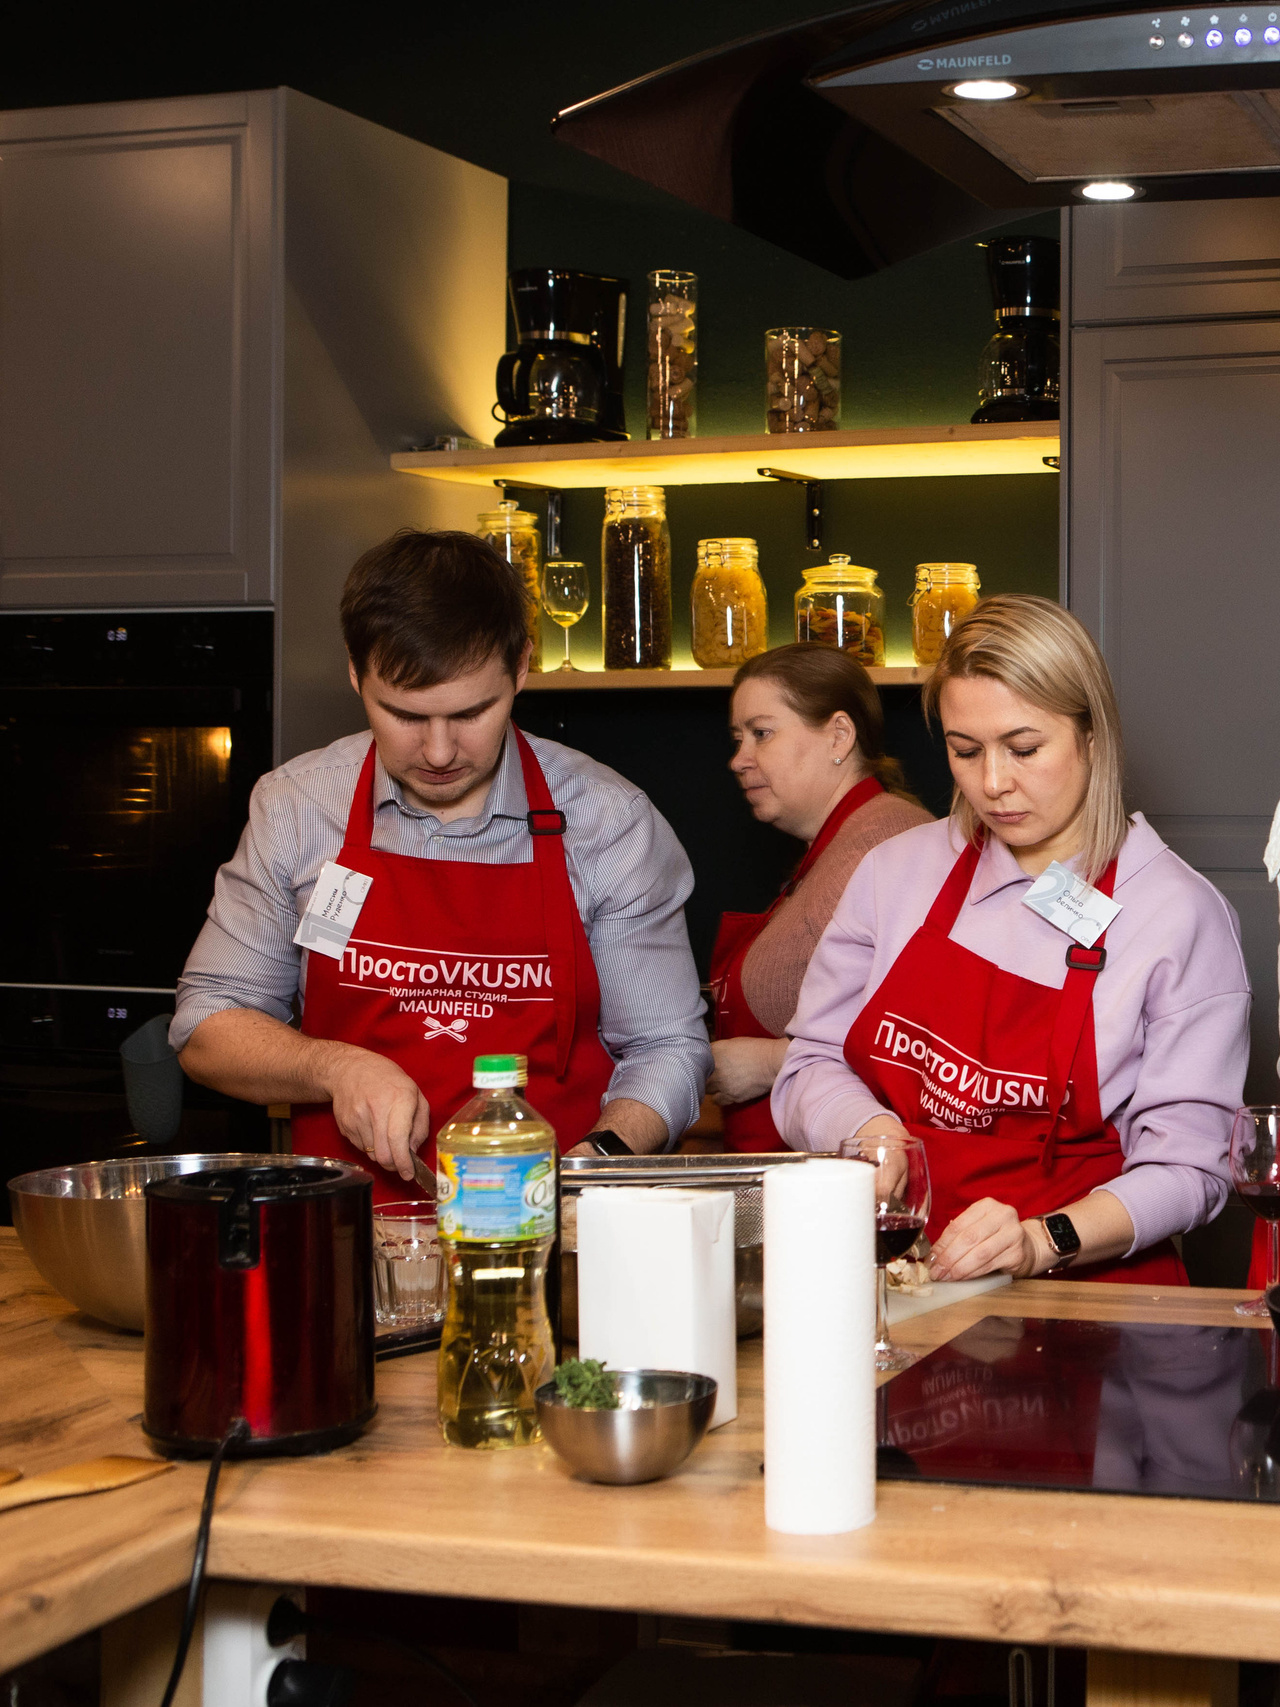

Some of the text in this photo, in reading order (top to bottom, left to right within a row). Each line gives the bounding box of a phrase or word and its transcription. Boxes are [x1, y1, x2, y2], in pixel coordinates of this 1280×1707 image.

[935, 54, 1012, 69] MAUNFELD
[389, 985, 508, 1003] КУЛИНАРНАЯ СТУДИЯ
[398, 1000, 494, 1019] MAUNFELD
